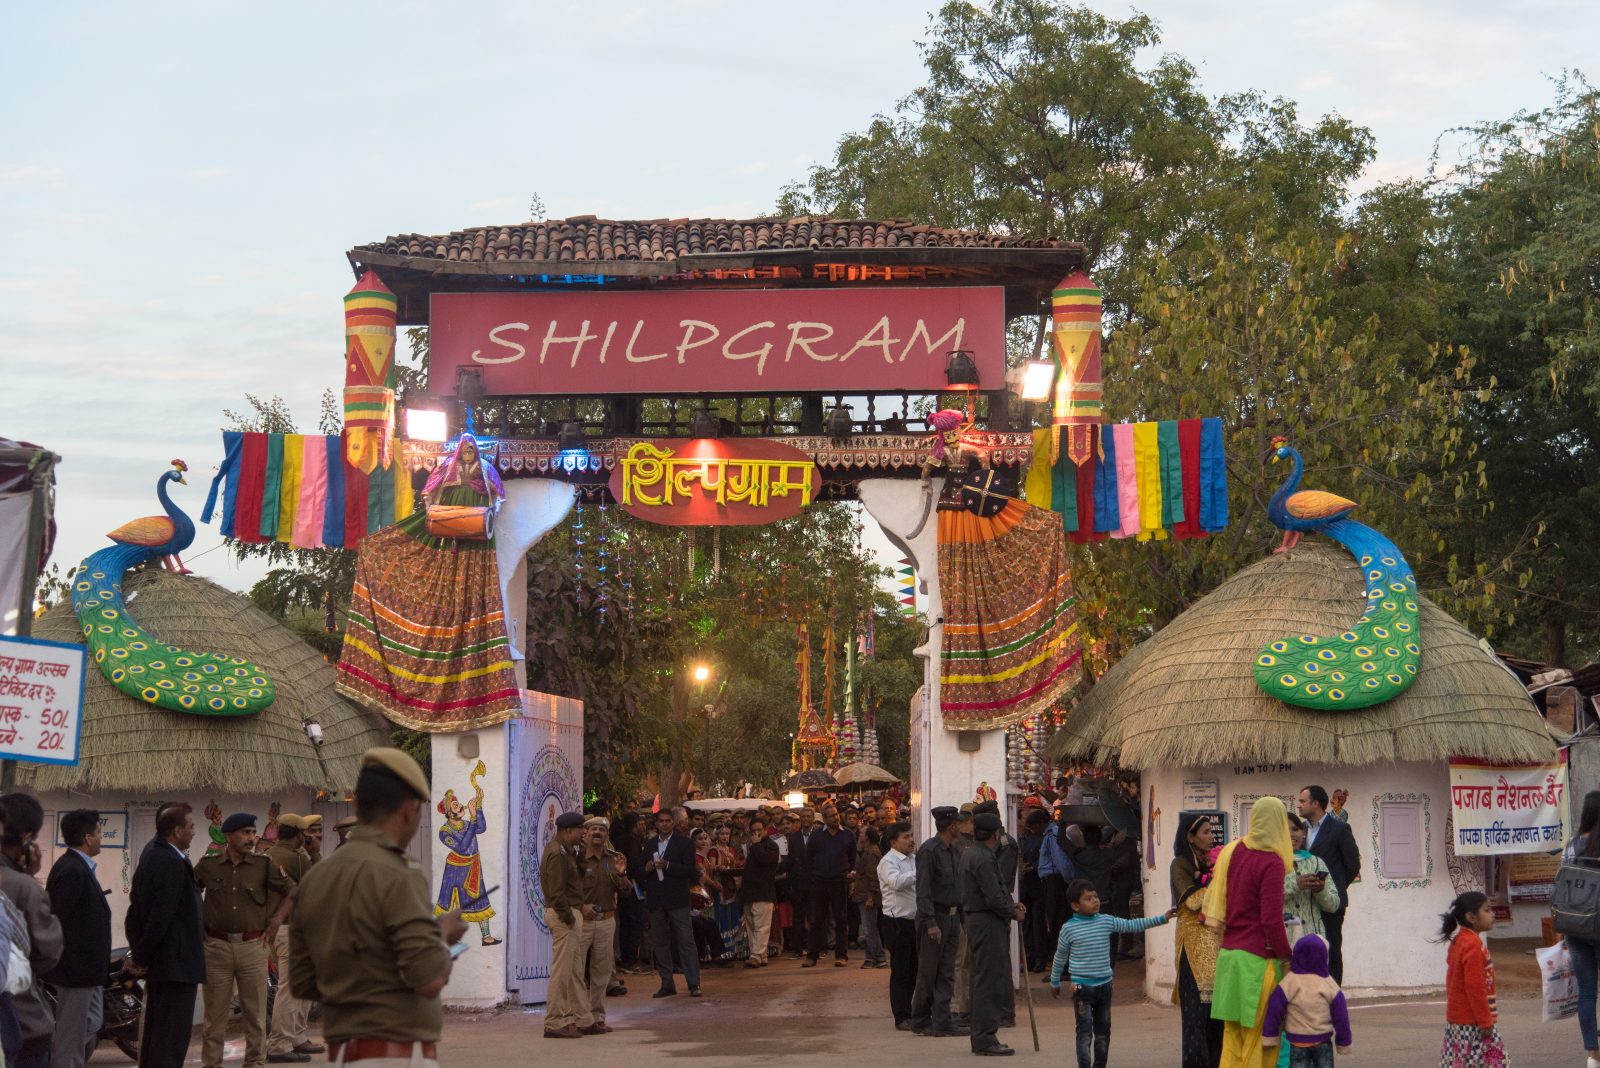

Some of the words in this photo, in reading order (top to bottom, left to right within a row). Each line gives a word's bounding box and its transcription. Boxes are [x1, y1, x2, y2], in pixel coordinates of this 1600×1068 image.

[471, 315, 966, 376] SHILPGRAM
[619, 442, 816, 507] शिल्पग्राम
[36, 662, 70, 678] उत्सव
[1242, 765, 1255, 775] AM
[1256, 764, 1268, 773] TO
[1279, 763, 1292, 772] PM
[1511, 826, 1541, 844] स्वागत
